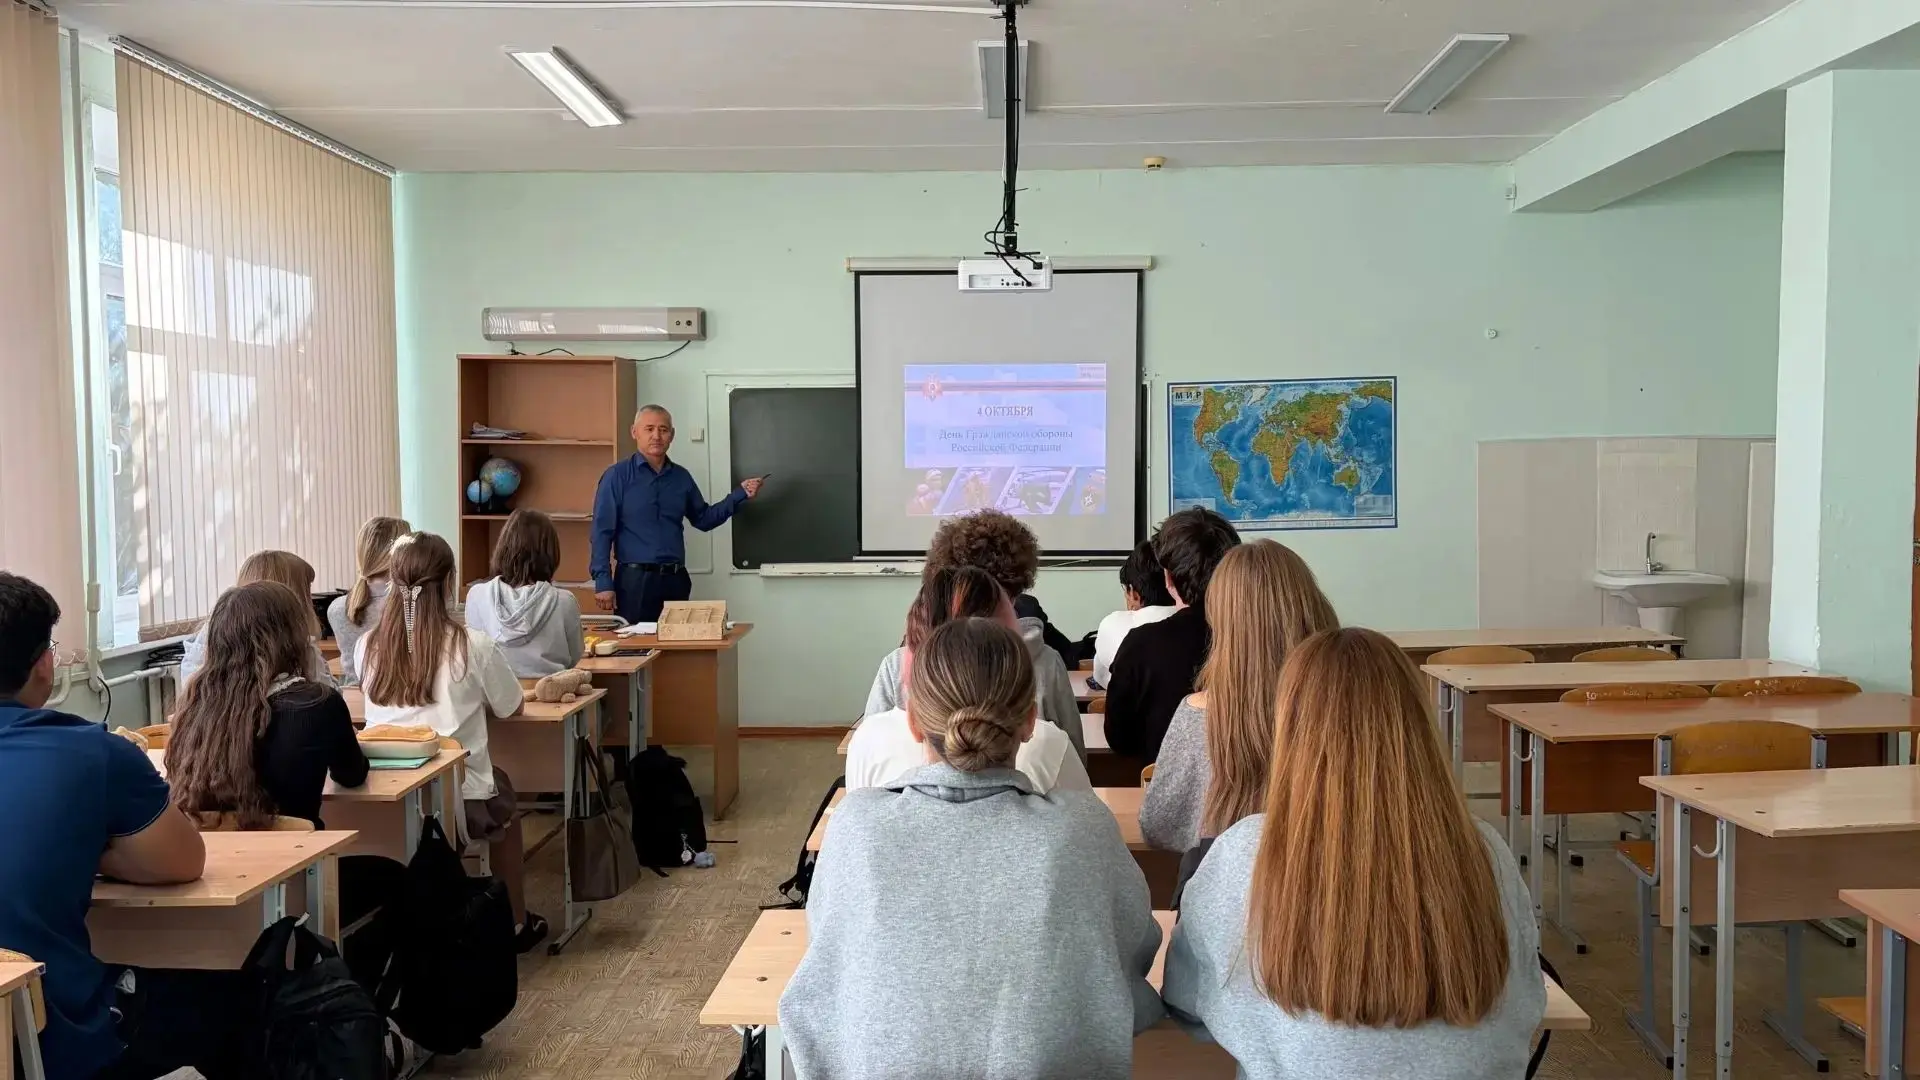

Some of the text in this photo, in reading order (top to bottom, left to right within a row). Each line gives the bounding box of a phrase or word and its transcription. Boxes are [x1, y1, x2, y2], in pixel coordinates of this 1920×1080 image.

[1175, 391, 1202, 400] МИР
[977, 406, 1034, 417] 4 ОКТЯБРЯ
[938, 428, 963, 441] День
